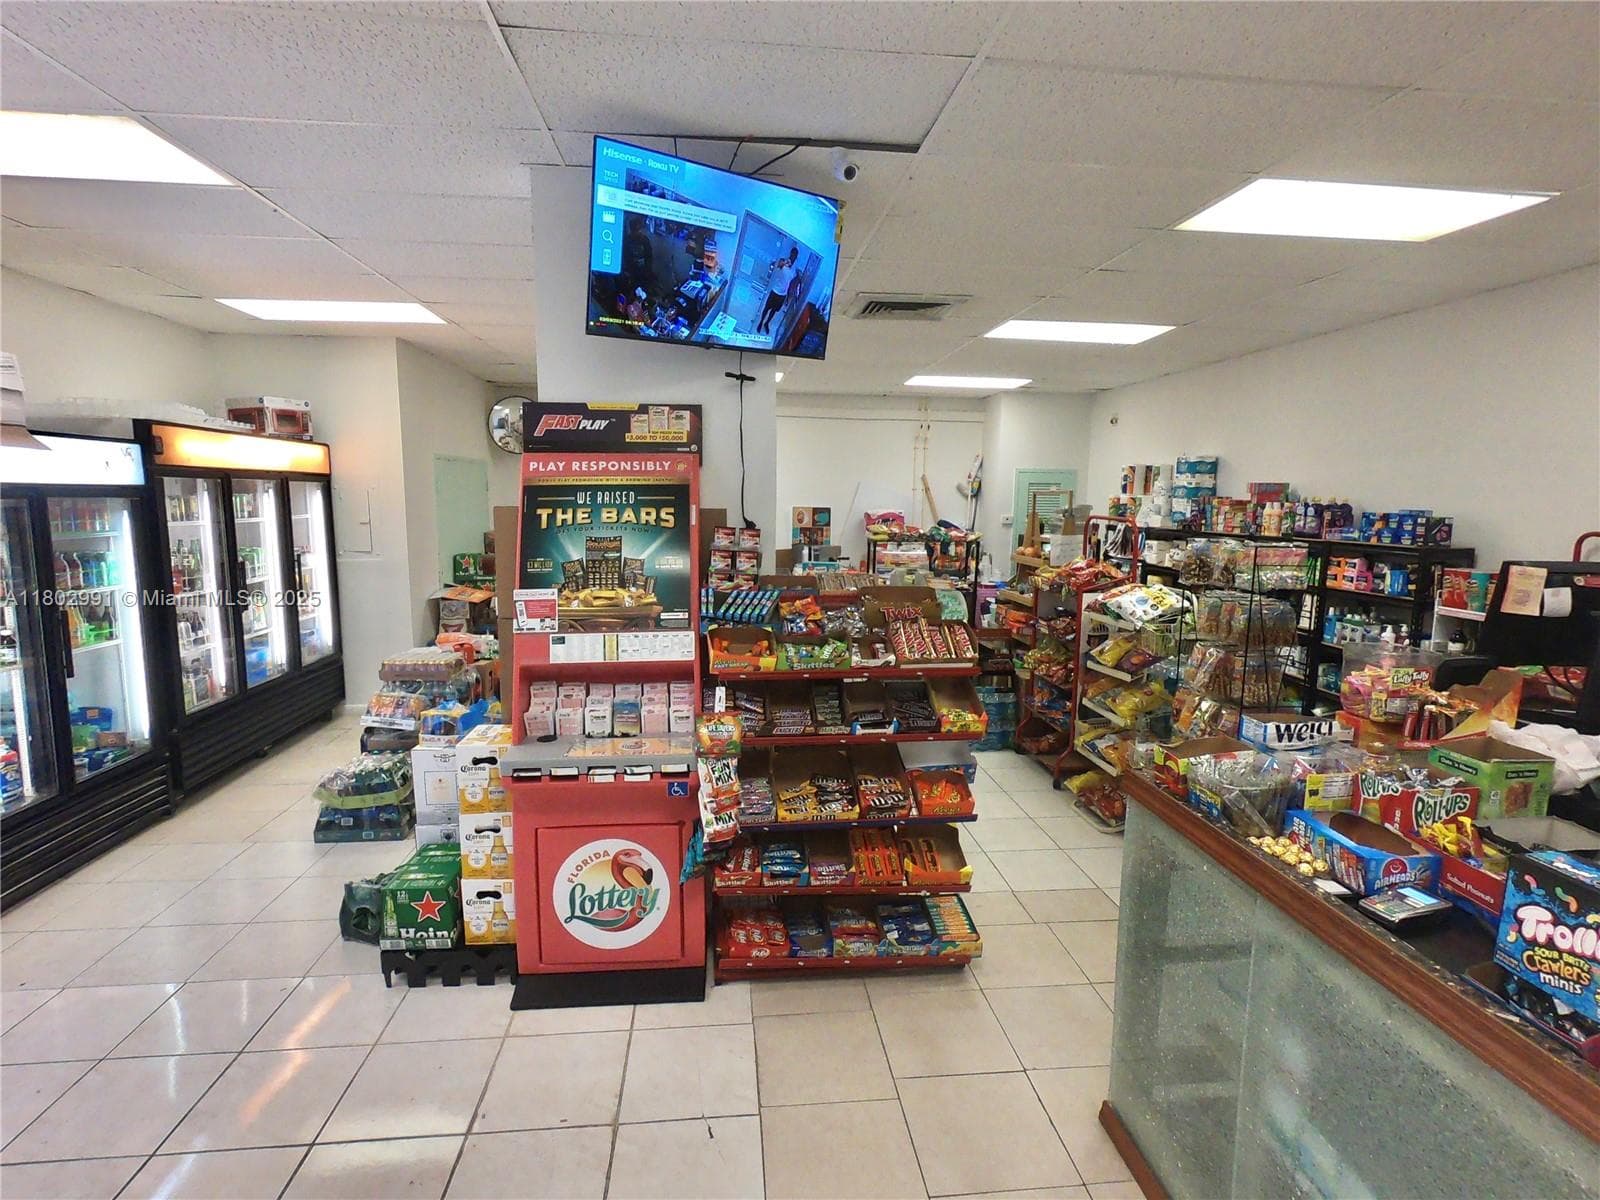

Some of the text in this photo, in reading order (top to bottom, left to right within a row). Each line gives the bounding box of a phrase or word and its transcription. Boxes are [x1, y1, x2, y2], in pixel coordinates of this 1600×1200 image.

[603, 147, 643, 164] Hisense
[669, 165, 679, 174] TV
[533, 414, 610, 437] FAST PLAY
[529, 461, 671, 472] PLAY RESPONSIBLY
[576, 491, 635, 504] WE RAISED
[536, 507, 676, 529] THE BARS
[461, 765, 486, 773] Corona
[1415, 793, 1470, 827] ROLL-UPS
[567, 850, 610, 884] FLORIDA
[1374, 871, 1417, 890] AIRHEADS
[465, 898, 491, 906] Corona
[564, 883, 660, 928] Lottery
[1534, 946, 1559, 960] SOUR
[1522, 950, 1591, 985] Crawlers
[1540, 972, 1583, 994] minis
